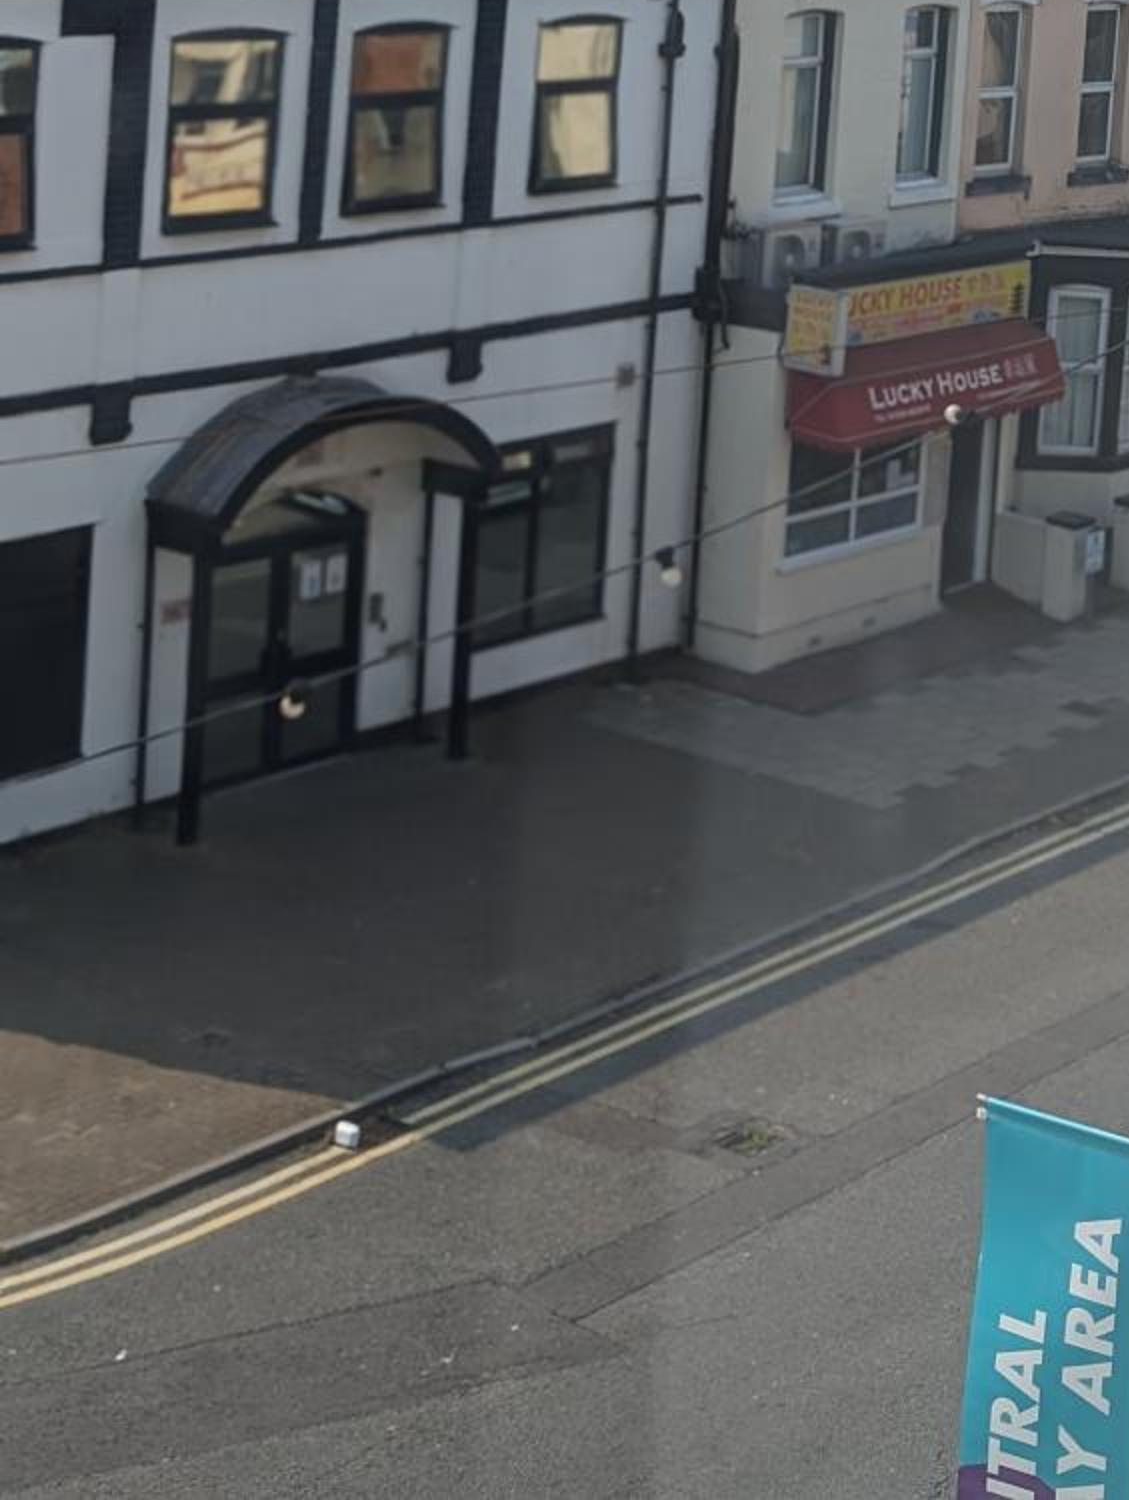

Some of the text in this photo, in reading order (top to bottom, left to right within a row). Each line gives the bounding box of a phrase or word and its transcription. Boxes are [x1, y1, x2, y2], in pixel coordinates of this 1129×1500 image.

[848, 289, 895, 317] UCKY
[899, 276, 961, 308] HOUSE
[868, 377, 934, 411] LUCKY
[936, 364, 1003, 397] HOUSE
[1062, 1218, 1122, 1416] AREA
